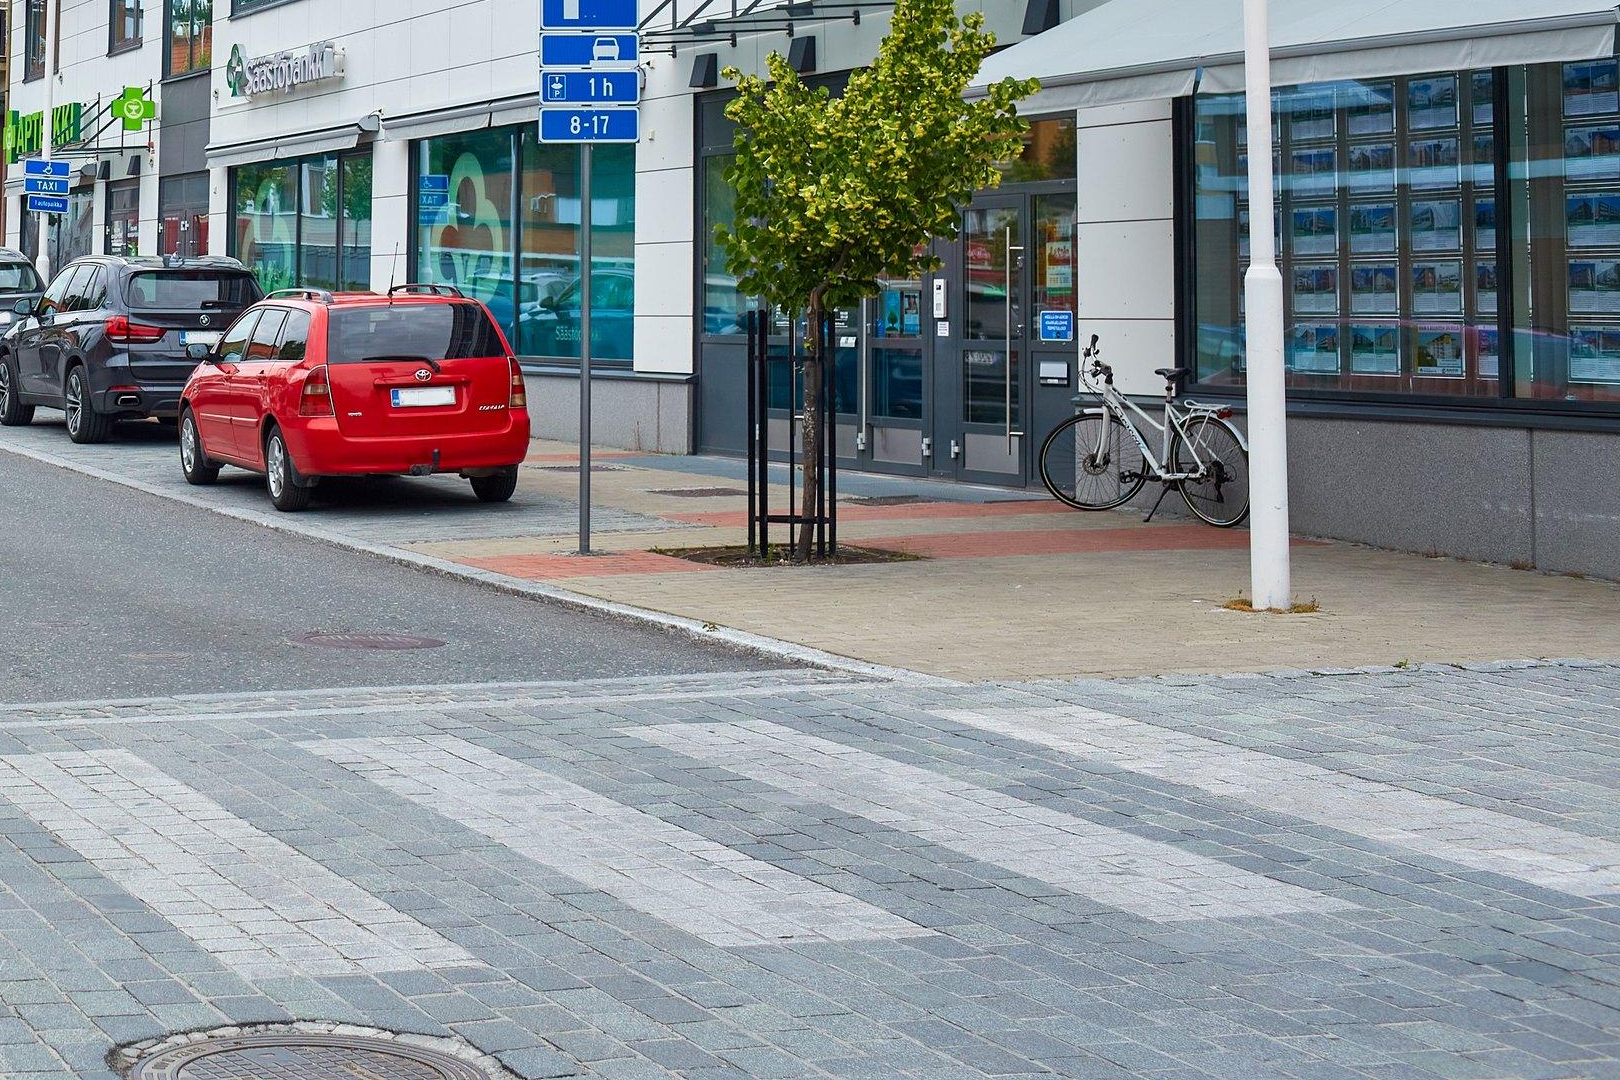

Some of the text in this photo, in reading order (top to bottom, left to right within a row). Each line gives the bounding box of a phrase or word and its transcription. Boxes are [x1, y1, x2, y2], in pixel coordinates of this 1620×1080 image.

[589, 77, 613, 96] 1 h
[17, 103, 76, 154] APTEKKI
[570, 115, 610, 135] 8-17
[36, 180, 58, 191] TAXI
